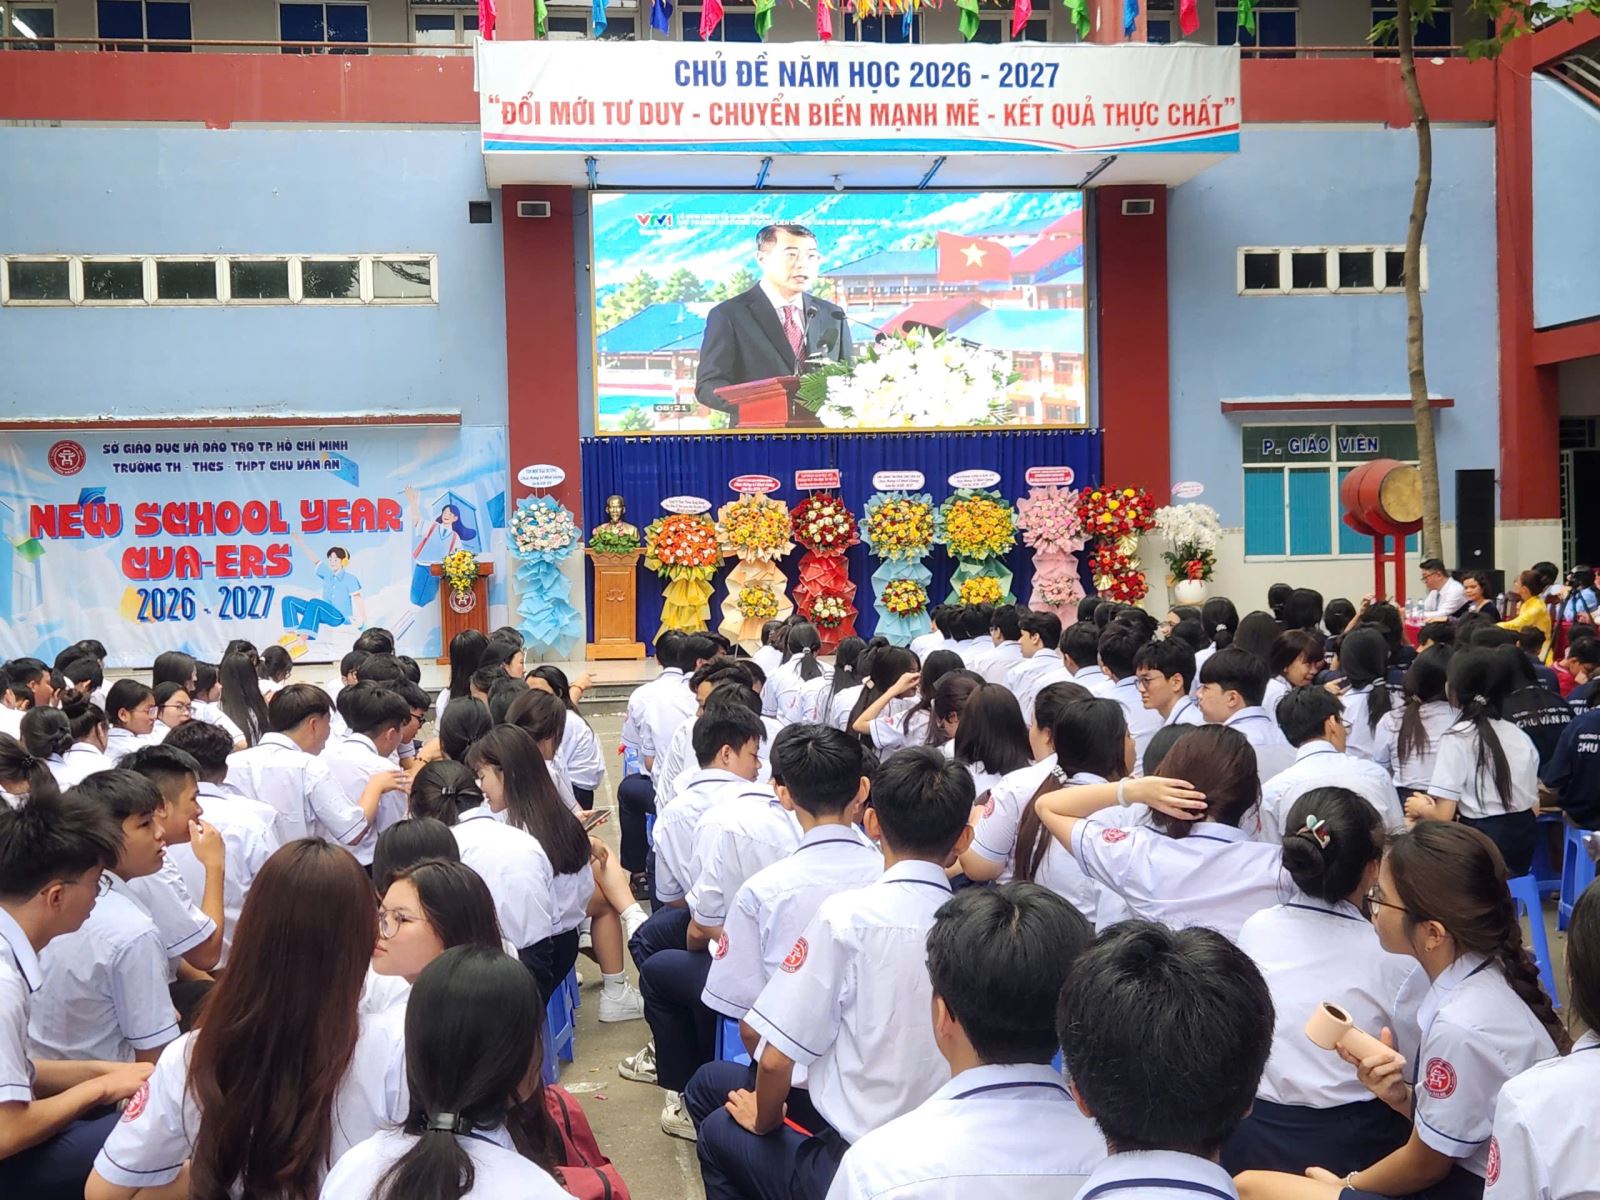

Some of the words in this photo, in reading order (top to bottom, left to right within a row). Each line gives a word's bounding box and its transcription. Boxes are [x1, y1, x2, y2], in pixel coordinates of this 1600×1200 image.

[675, 51, 726, 87] CHỦ
[736, 52, 768, 87] ĐỀ
[779, 55, 839, 87] NĂM
[848, 61, 900, 93] HỌC
[909, 62, 971, 88] 2026
[999, 62, 1060, 88] 2027
[550, 97, 595, 125] MỚI
[602, 100, 631, 125] TƯ
[639, 101, 683, 125] DUY
[710, 92, 800, 126] CHUYỂN
[809, 95, 861, 126] BIẾN
[870, 102, 937, 131] MẠNH
[946, 98, 979, 126] MẼ
[1004, 95, 1043, 126] KẾT
[1052, 95, 1096, 127] QUẢ
[1103, 103, 1159, 131] THỰC
[636, 214, 672, 226] VTV1
[102, 441, 119, 454] SỞ
[123, 441, 151, 454] GIÁO
[155, 443, 180, 455] DỤC
[231, 442, 254, 454] TẠO
[277, 438, 292, 451] HỒ
[296, 439, 315, 451] CHÍ
[319, 441, 348, 451] MINH
[1262, 438, 1281, 455] P.
[1288, 433, 1330, 454] GIÁO
[1338, 433, 1379, 453] VIÊN
[113, 460, 162, 473] TRƯỜNG
[165, 462, 181, 472] TH
[192, 461, 224, 472] THCS
[235, 461, 266, 471] THPT
[270, 460, 293, 471] CHU
[324, 460, 340, 470] AN
[30, 503, 123, 539] NEW
[135, 500, 290, 537] SCHOOL
[300, 498, 403, 534] YEAR
[137, 587, 196, 622] 2026
[218, 585, 275, 620] 2027
